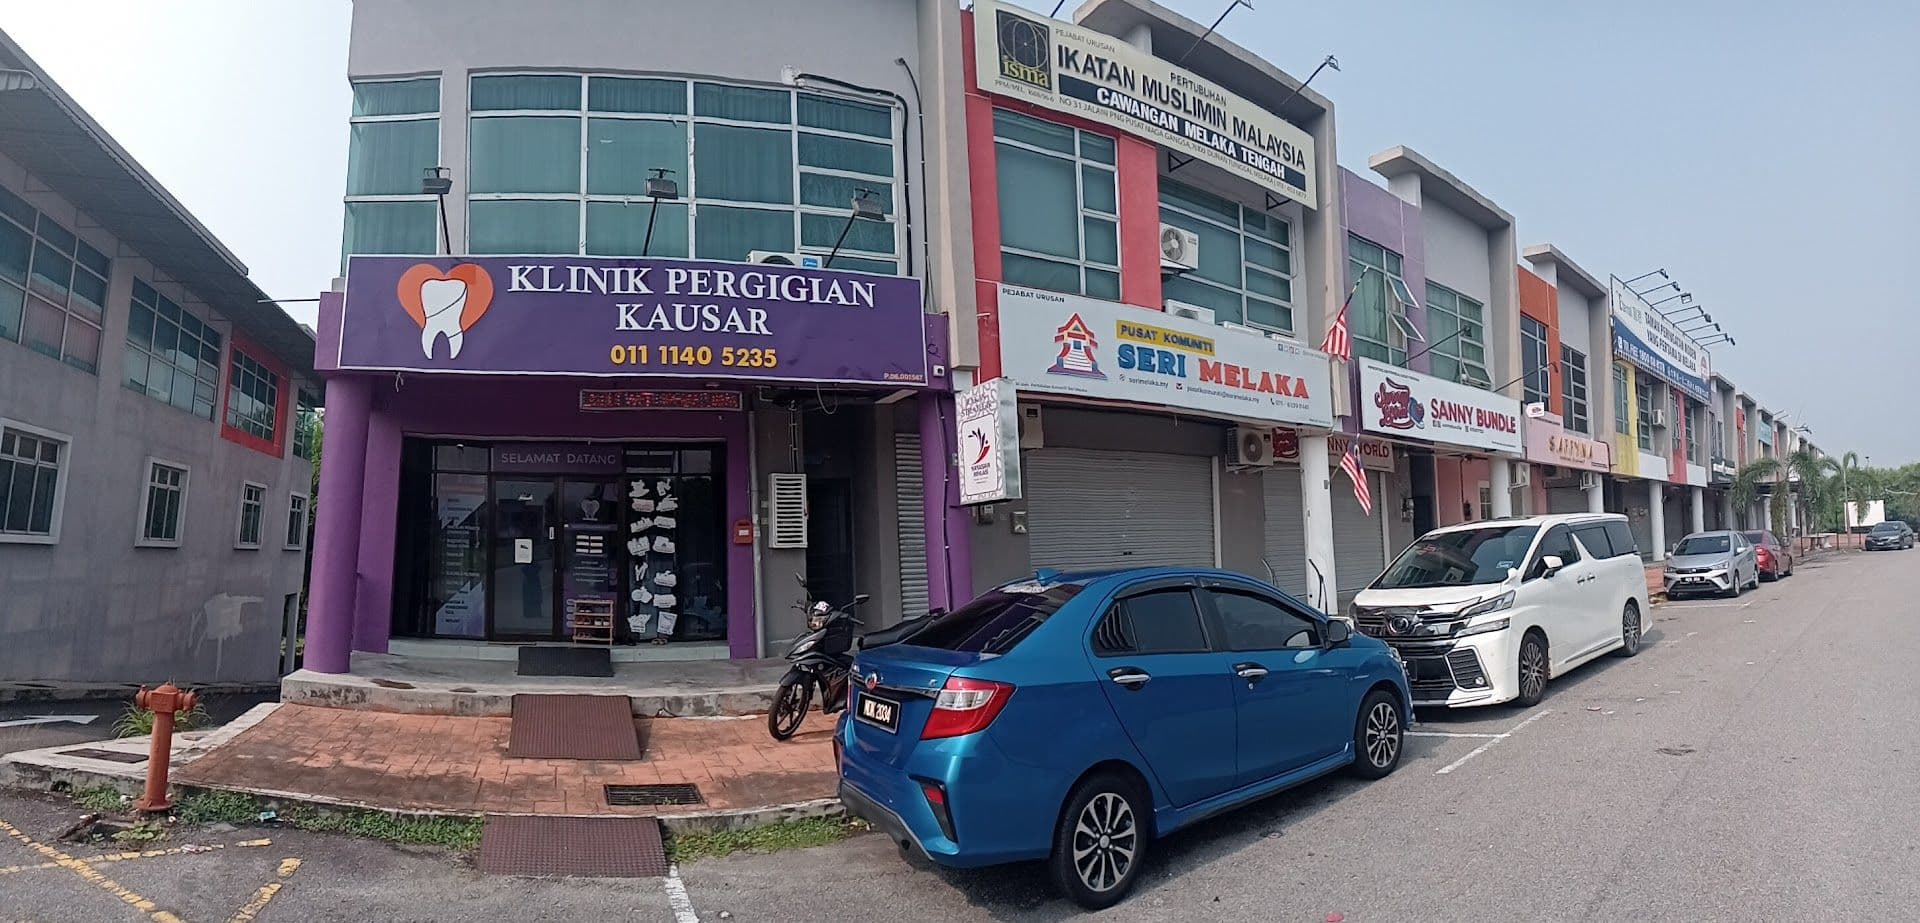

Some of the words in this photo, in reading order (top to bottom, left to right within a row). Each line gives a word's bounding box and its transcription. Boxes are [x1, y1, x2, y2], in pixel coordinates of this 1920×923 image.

[1055, 28, 1084, 43] PEJABAT
[1002, 55, 1049, 87] isma
[1170, 72, 1227, 107] PERTUBUHAN
[1058, 44, 1136, 92] IKATAN
[1142, 74, 1227, 131] MUSLIMIN
[1233, 116, 1306, 170] MALAYSIA
[1096, 87, 1179, 132] CAWANGAN
[1185, 120, 1237, 158] MELAKA
[1241, 146, 1286, 179] TENGAH
[1125, 117, 1145, 130] PUSAT
[507, 265, 654, 295] KLINIK
[664, 268, 876, 308] PERGIGIAN
[1002, 287, 1034, 299] PEJABAT
[1036, 292, 1065, 303] URUSAN
[615, 303, 773, 336] KAUSAR
[1121, 324, 1158, 341] PUSAT
[1163, 332, 1213, 353] KOMUNITI
[610, 345, 648, 365] 011
[658, 346, 713, 366] 1140
[721, 347, 778, 368] 5235
[1117, 343, 1187, 378] SERI
[1198, 358, 1310, 399] MELAKA
[1431, 398, 1474, 425] SANNY
[1476, 408, 1517, 434] BUNDLE
[502, 453, 561, 464] SELAMAT
[567, 453, 617, 465] DATANG
[1360, 441, 1390, 458] ORLD
